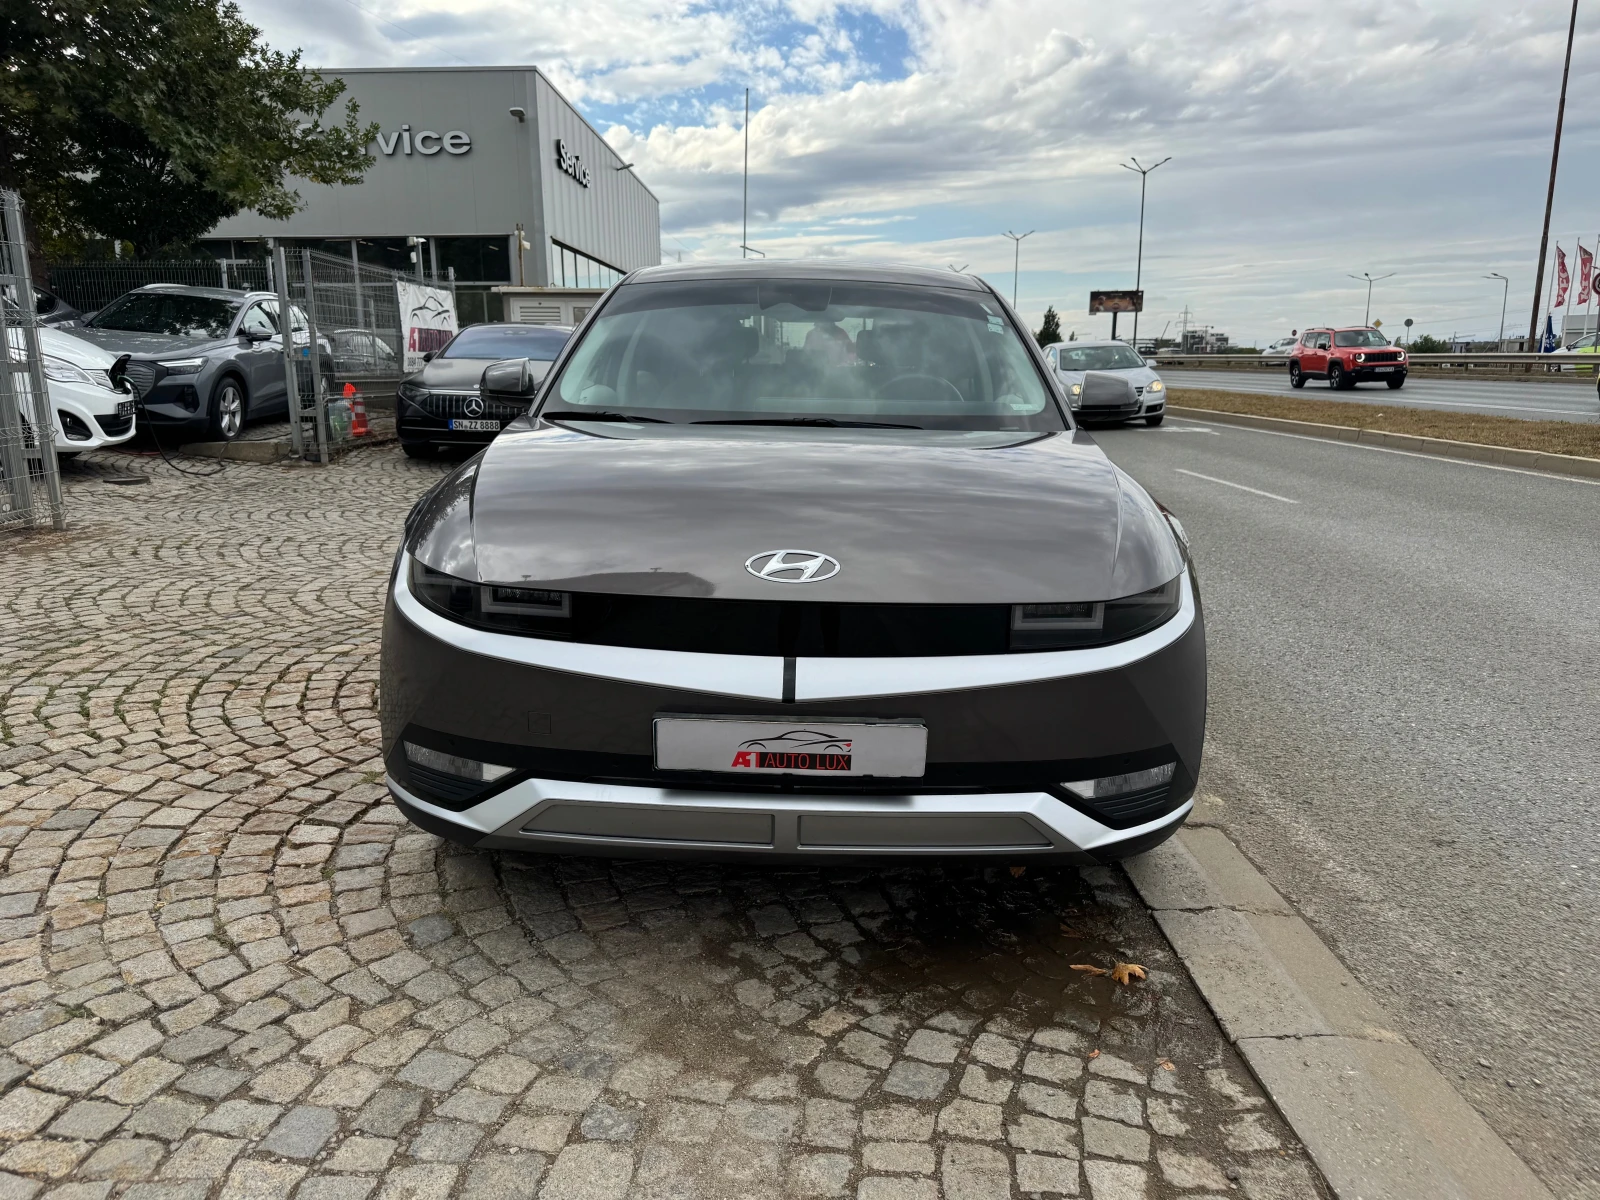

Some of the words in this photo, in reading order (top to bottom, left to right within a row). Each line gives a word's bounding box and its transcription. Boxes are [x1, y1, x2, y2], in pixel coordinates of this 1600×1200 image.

[559, 139, 590, 188] Service
[453, 420, 464, 429] SN
[468, 420, 479, 430] ZZ
[479, 421, 500, 430] 8888
[731, 751, 760, 768] A1
[764, 753, 810, 769] AUTO
[816, 754, 849, 770] LUX
